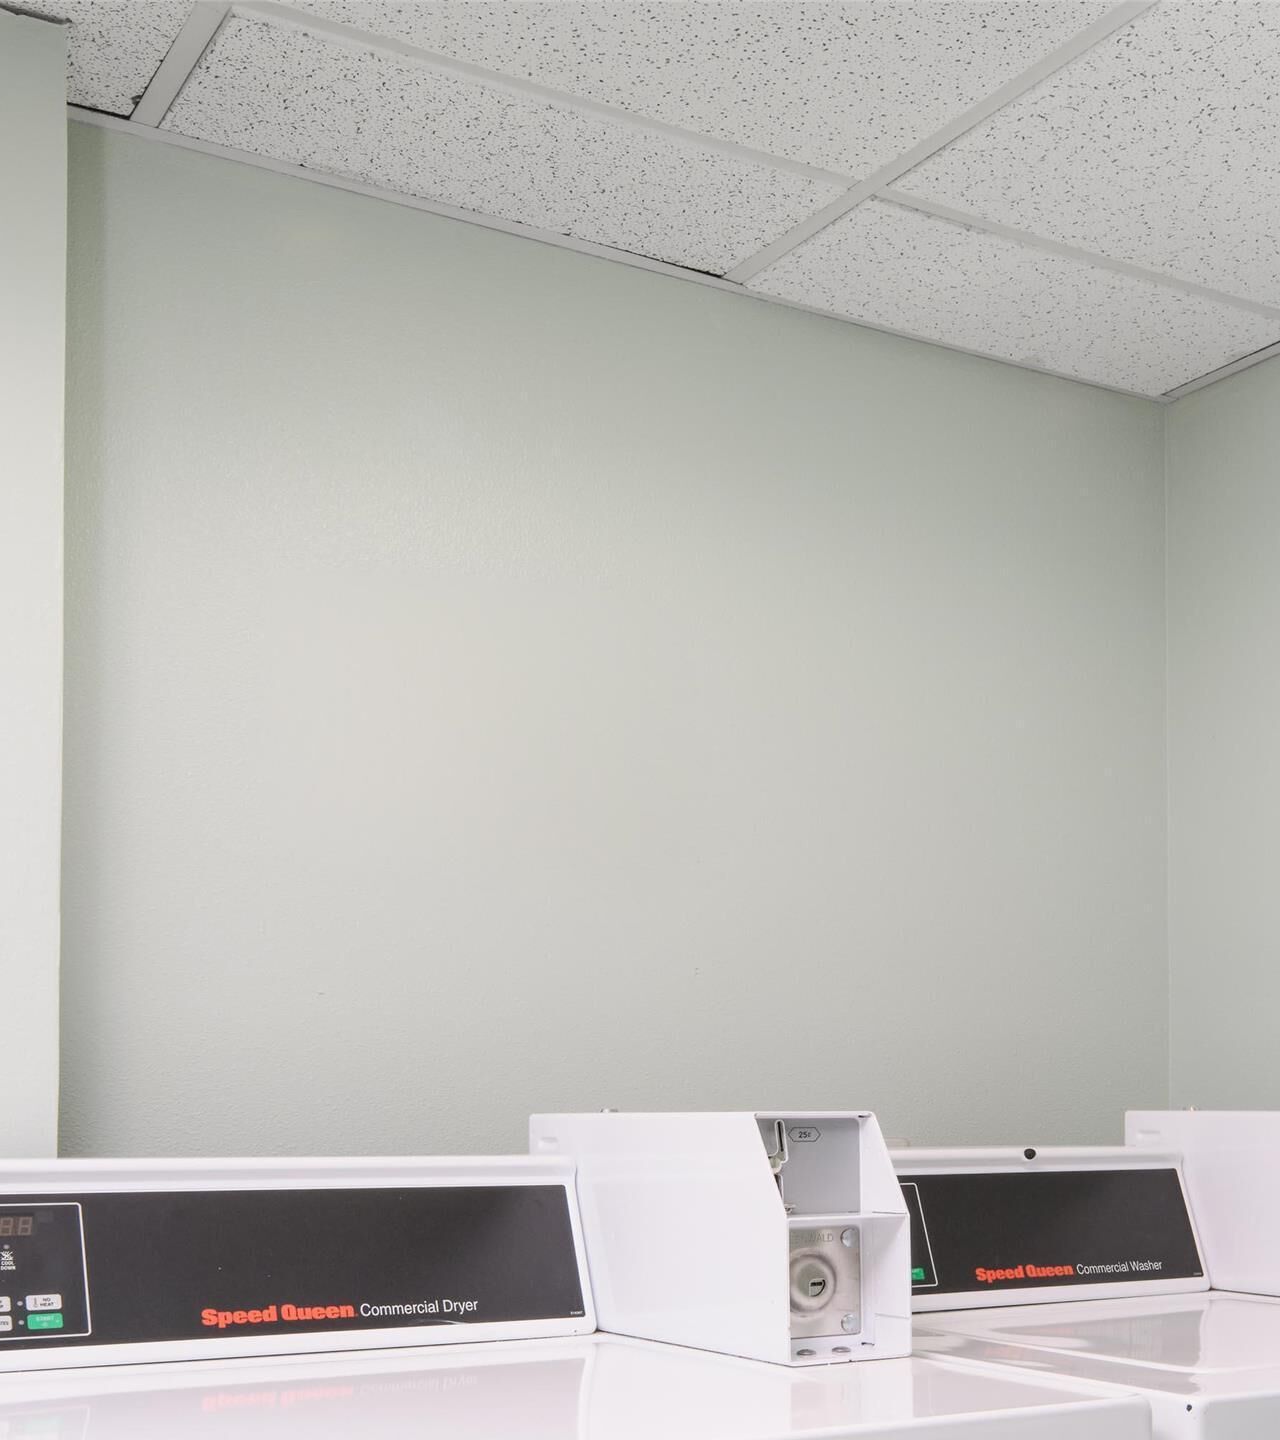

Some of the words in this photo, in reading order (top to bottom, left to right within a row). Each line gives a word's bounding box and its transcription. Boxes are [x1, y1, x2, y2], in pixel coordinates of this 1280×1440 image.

[975, 1265, 1024, 1283] Speed
[1025, 1263, 1074, 1279] Queen
[1076, 1260, 1129, 1275] Commercial
[1129, 1259, 1163, 1272] Washer
[201, 1305, 278, 1328] Speed
[281, 1303, 355, 1322] Queen
[360, 1299, 440, 1317] Commercial
[443, 1298, 479, 1315] Dryer
